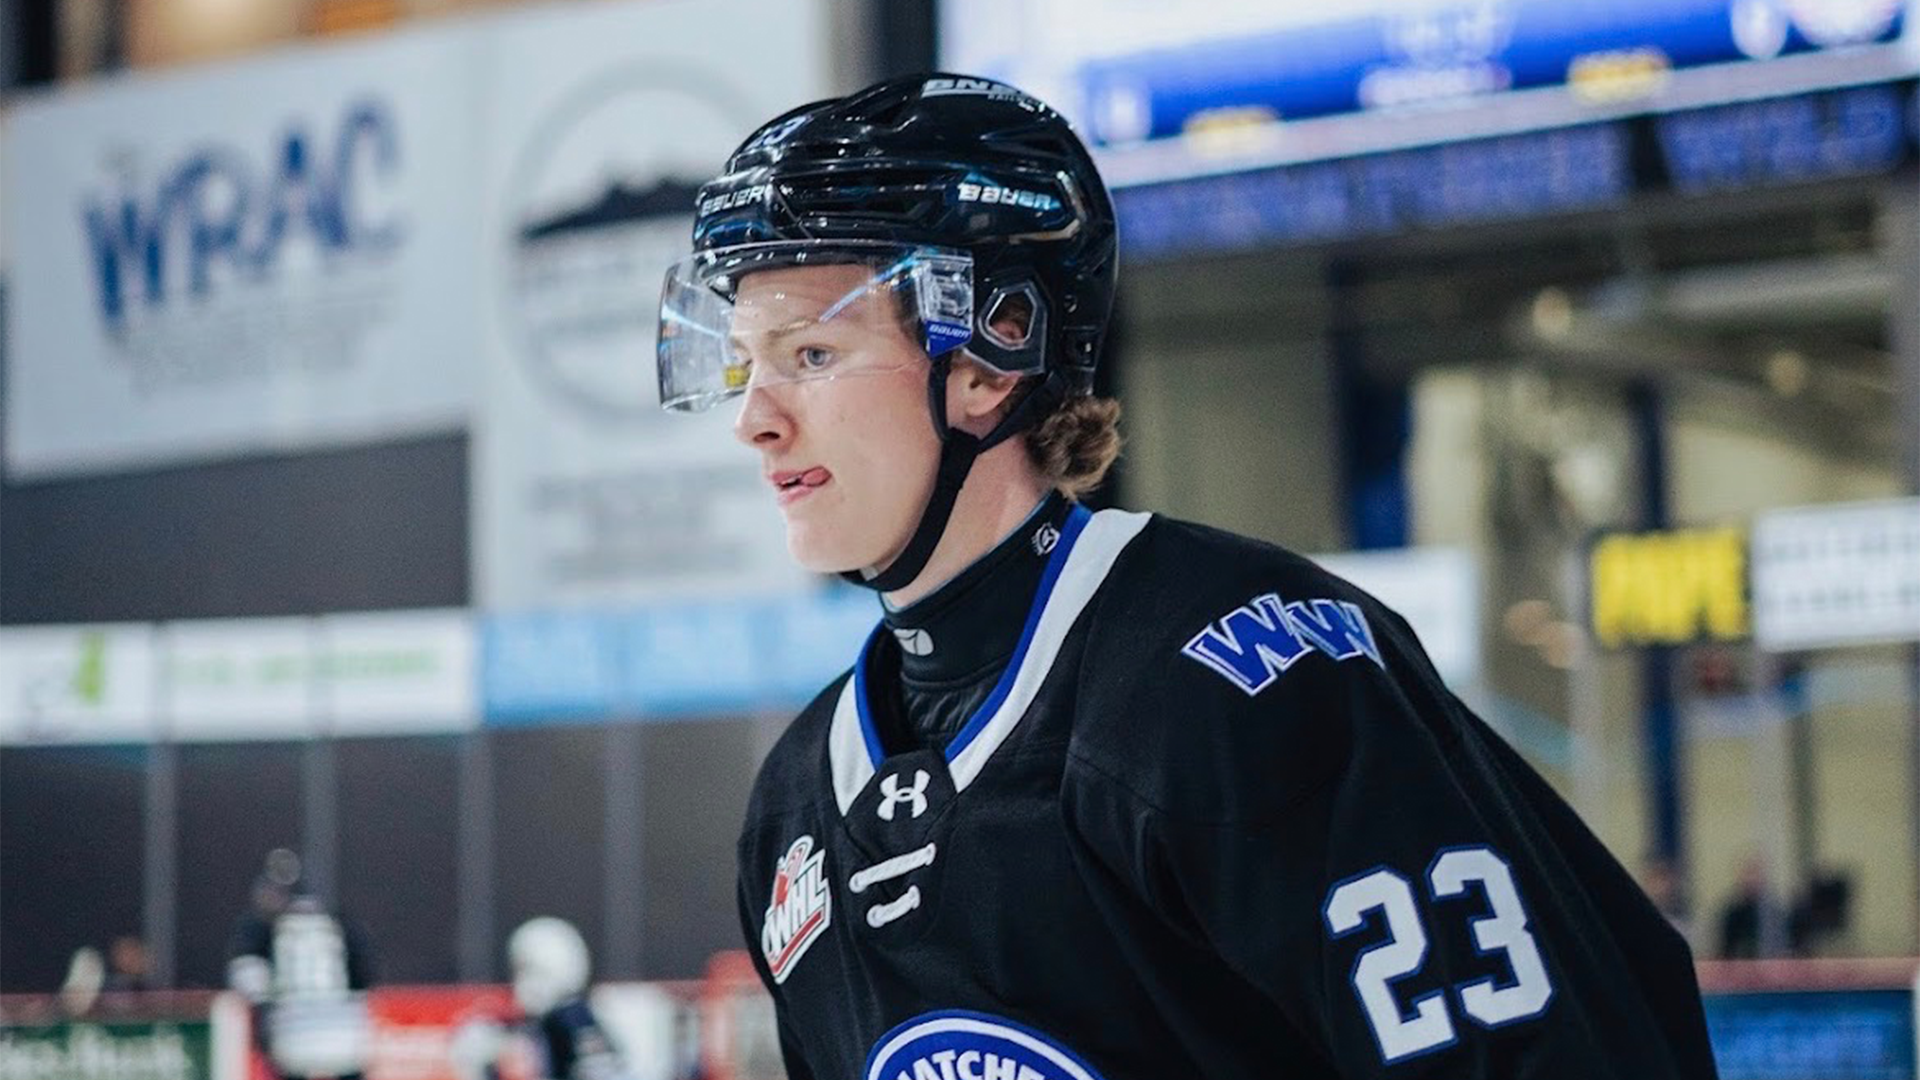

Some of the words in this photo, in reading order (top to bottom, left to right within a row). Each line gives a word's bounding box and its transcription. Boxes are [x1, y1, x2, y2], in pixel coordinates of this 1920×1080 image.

[80, 98, 404, 330] WRAC
[763, 856, 829, 962] WHL
[1321, 844, 1554, 1066] 23
